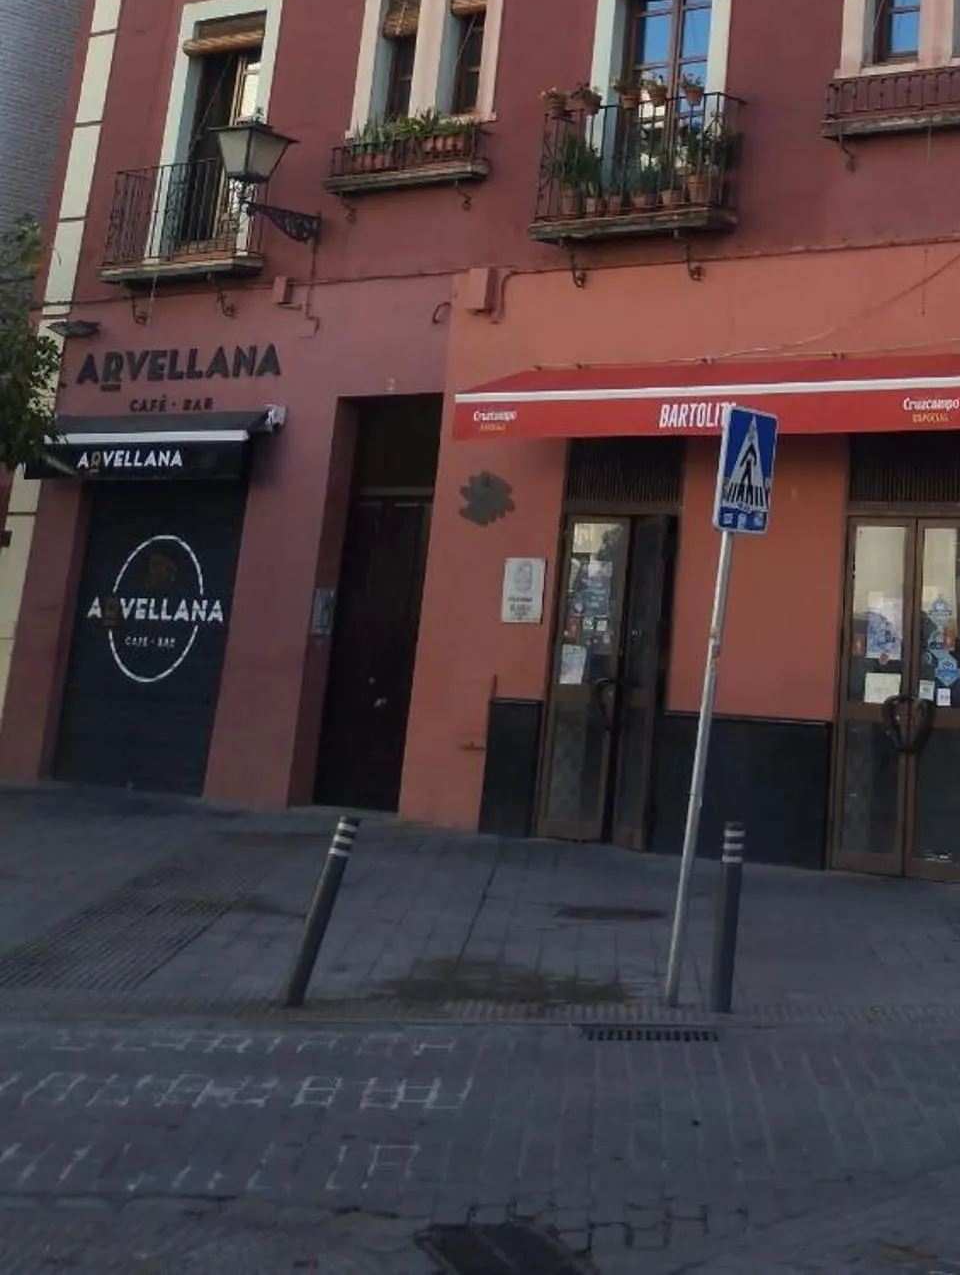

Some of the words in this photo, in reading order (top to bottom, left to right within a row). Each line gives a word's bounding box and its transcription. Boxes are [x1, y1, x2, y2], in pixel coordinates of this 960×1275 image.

[76, 343, 282, 388] ARVELLANA
[129, 395, 168, 413] CAFÉ
[182, 397, 214, 412] BAR
[659, 401, 737, 428] BARTOLIT
